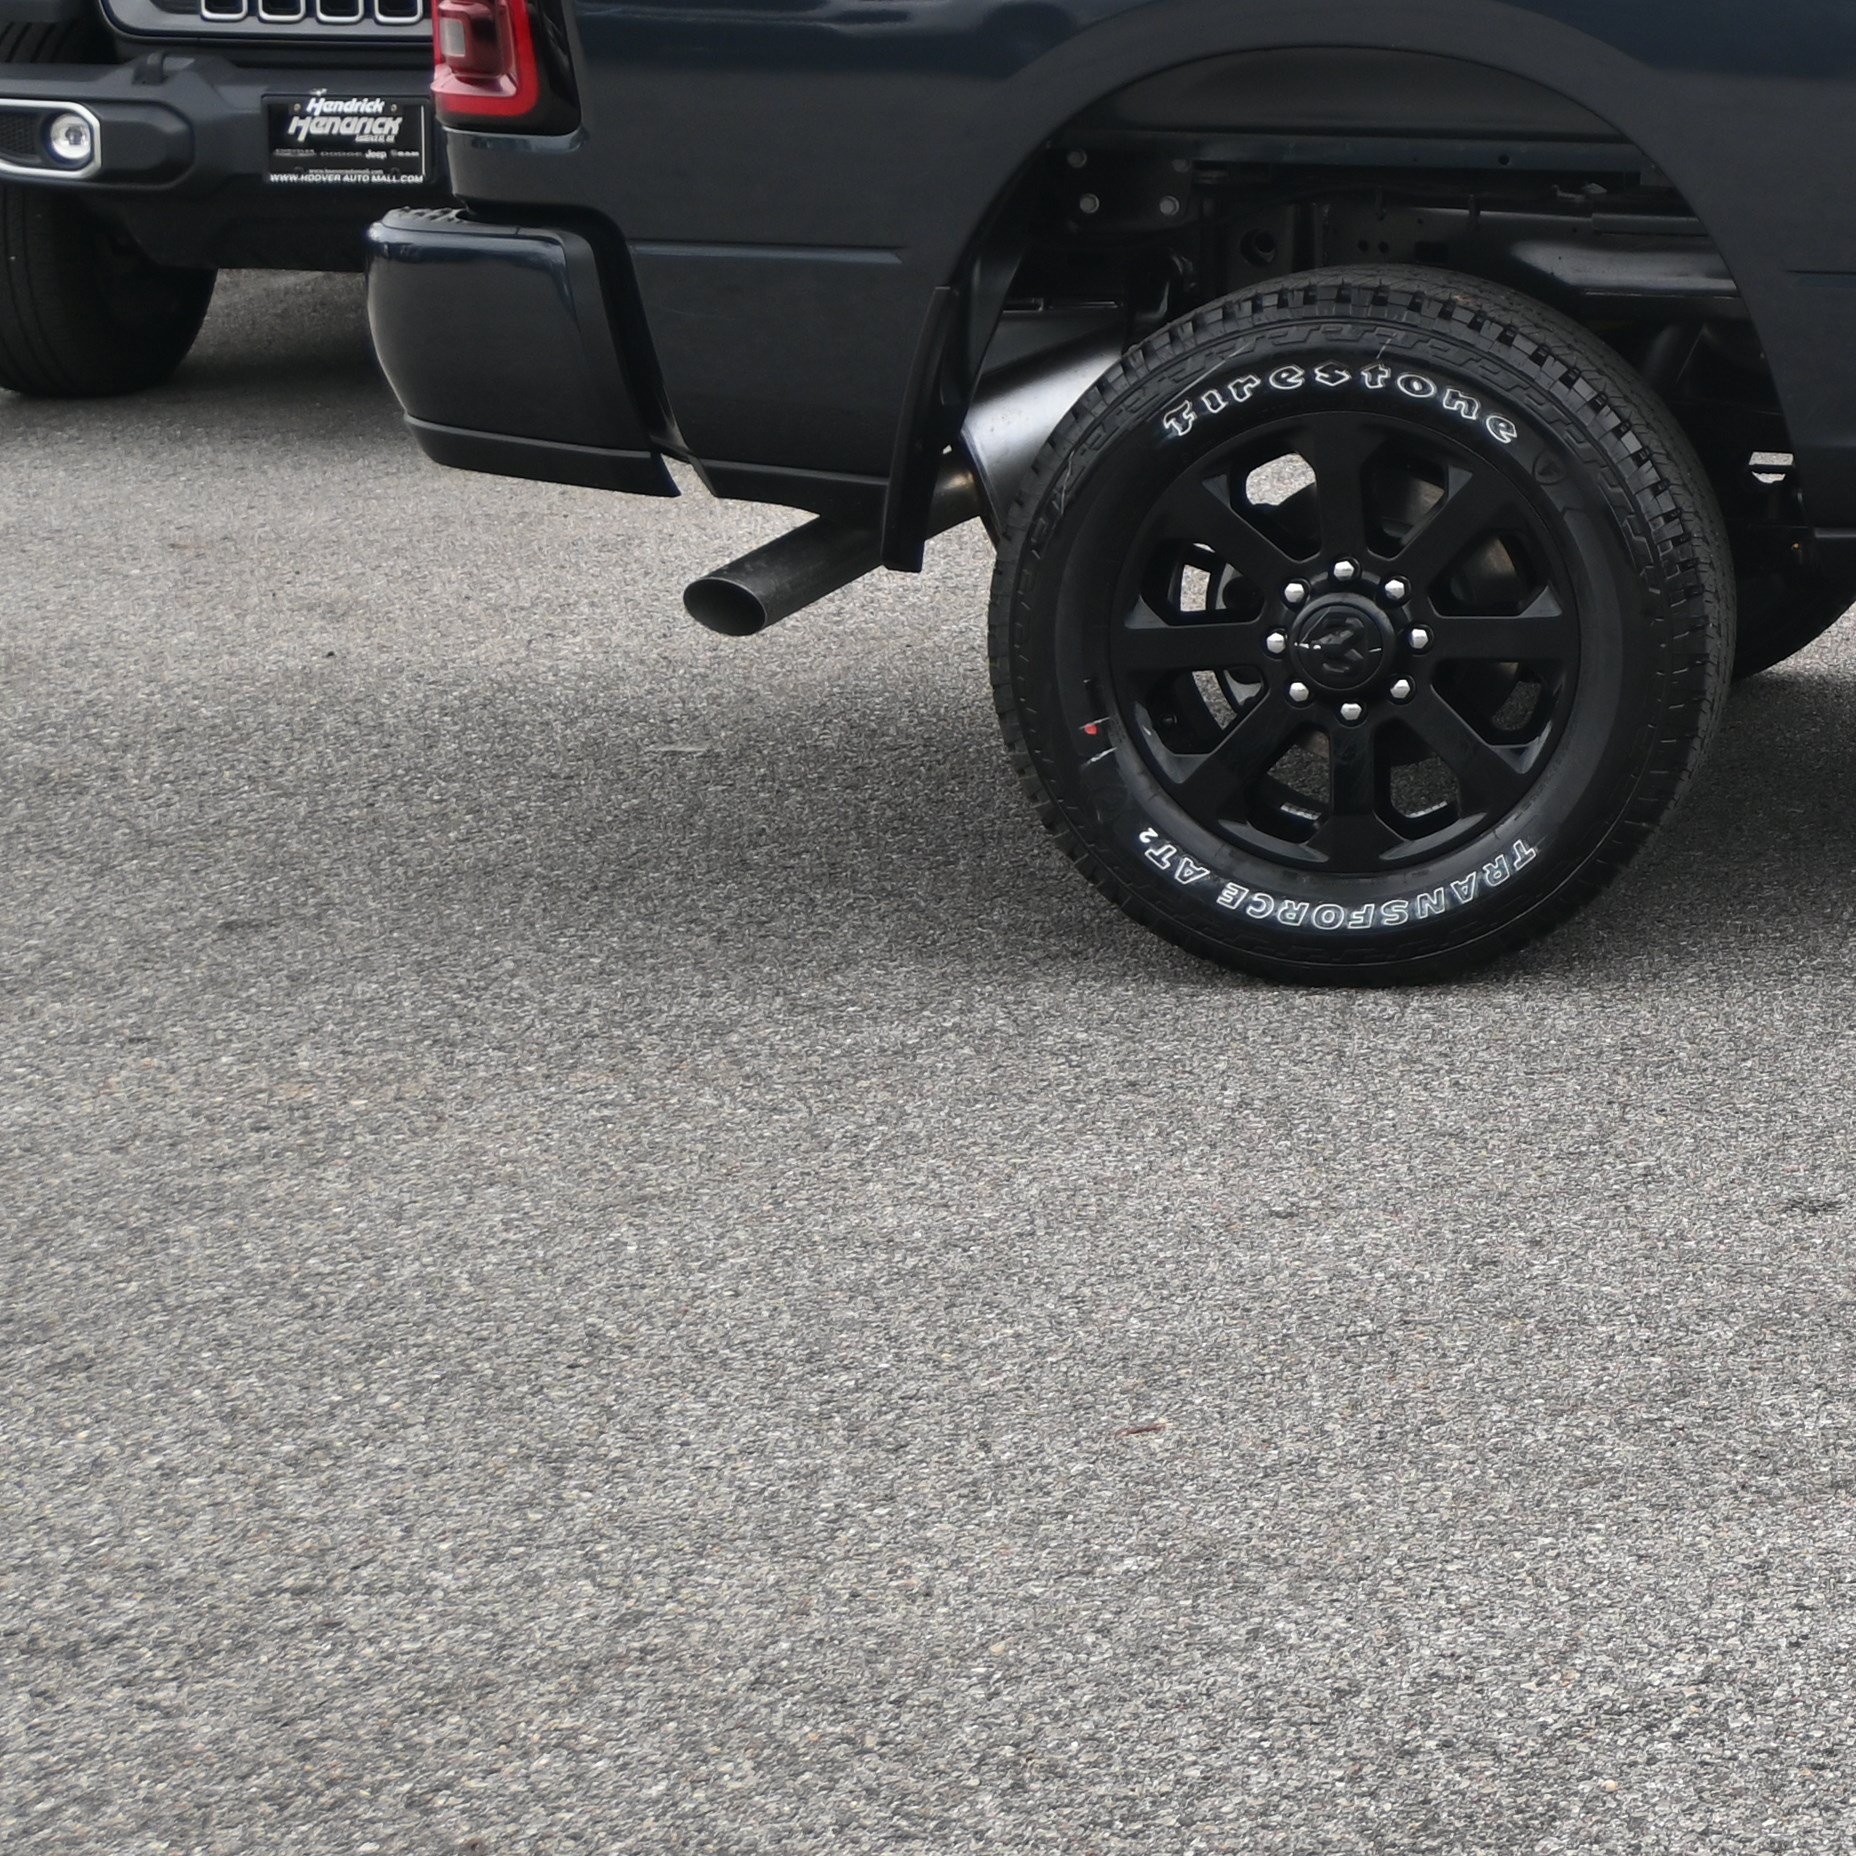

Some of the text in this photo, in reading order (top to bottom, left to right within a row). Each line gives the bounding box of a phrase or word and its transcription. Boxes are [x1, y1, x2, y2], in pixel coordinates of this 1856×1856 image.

[306, 97, 385, 116] Hendrick
[365, 149, 388, 160] Jeep
[342, 174, 370, 183] AUTO
[1215, 839, 1537, 931] TRANSFORCE
